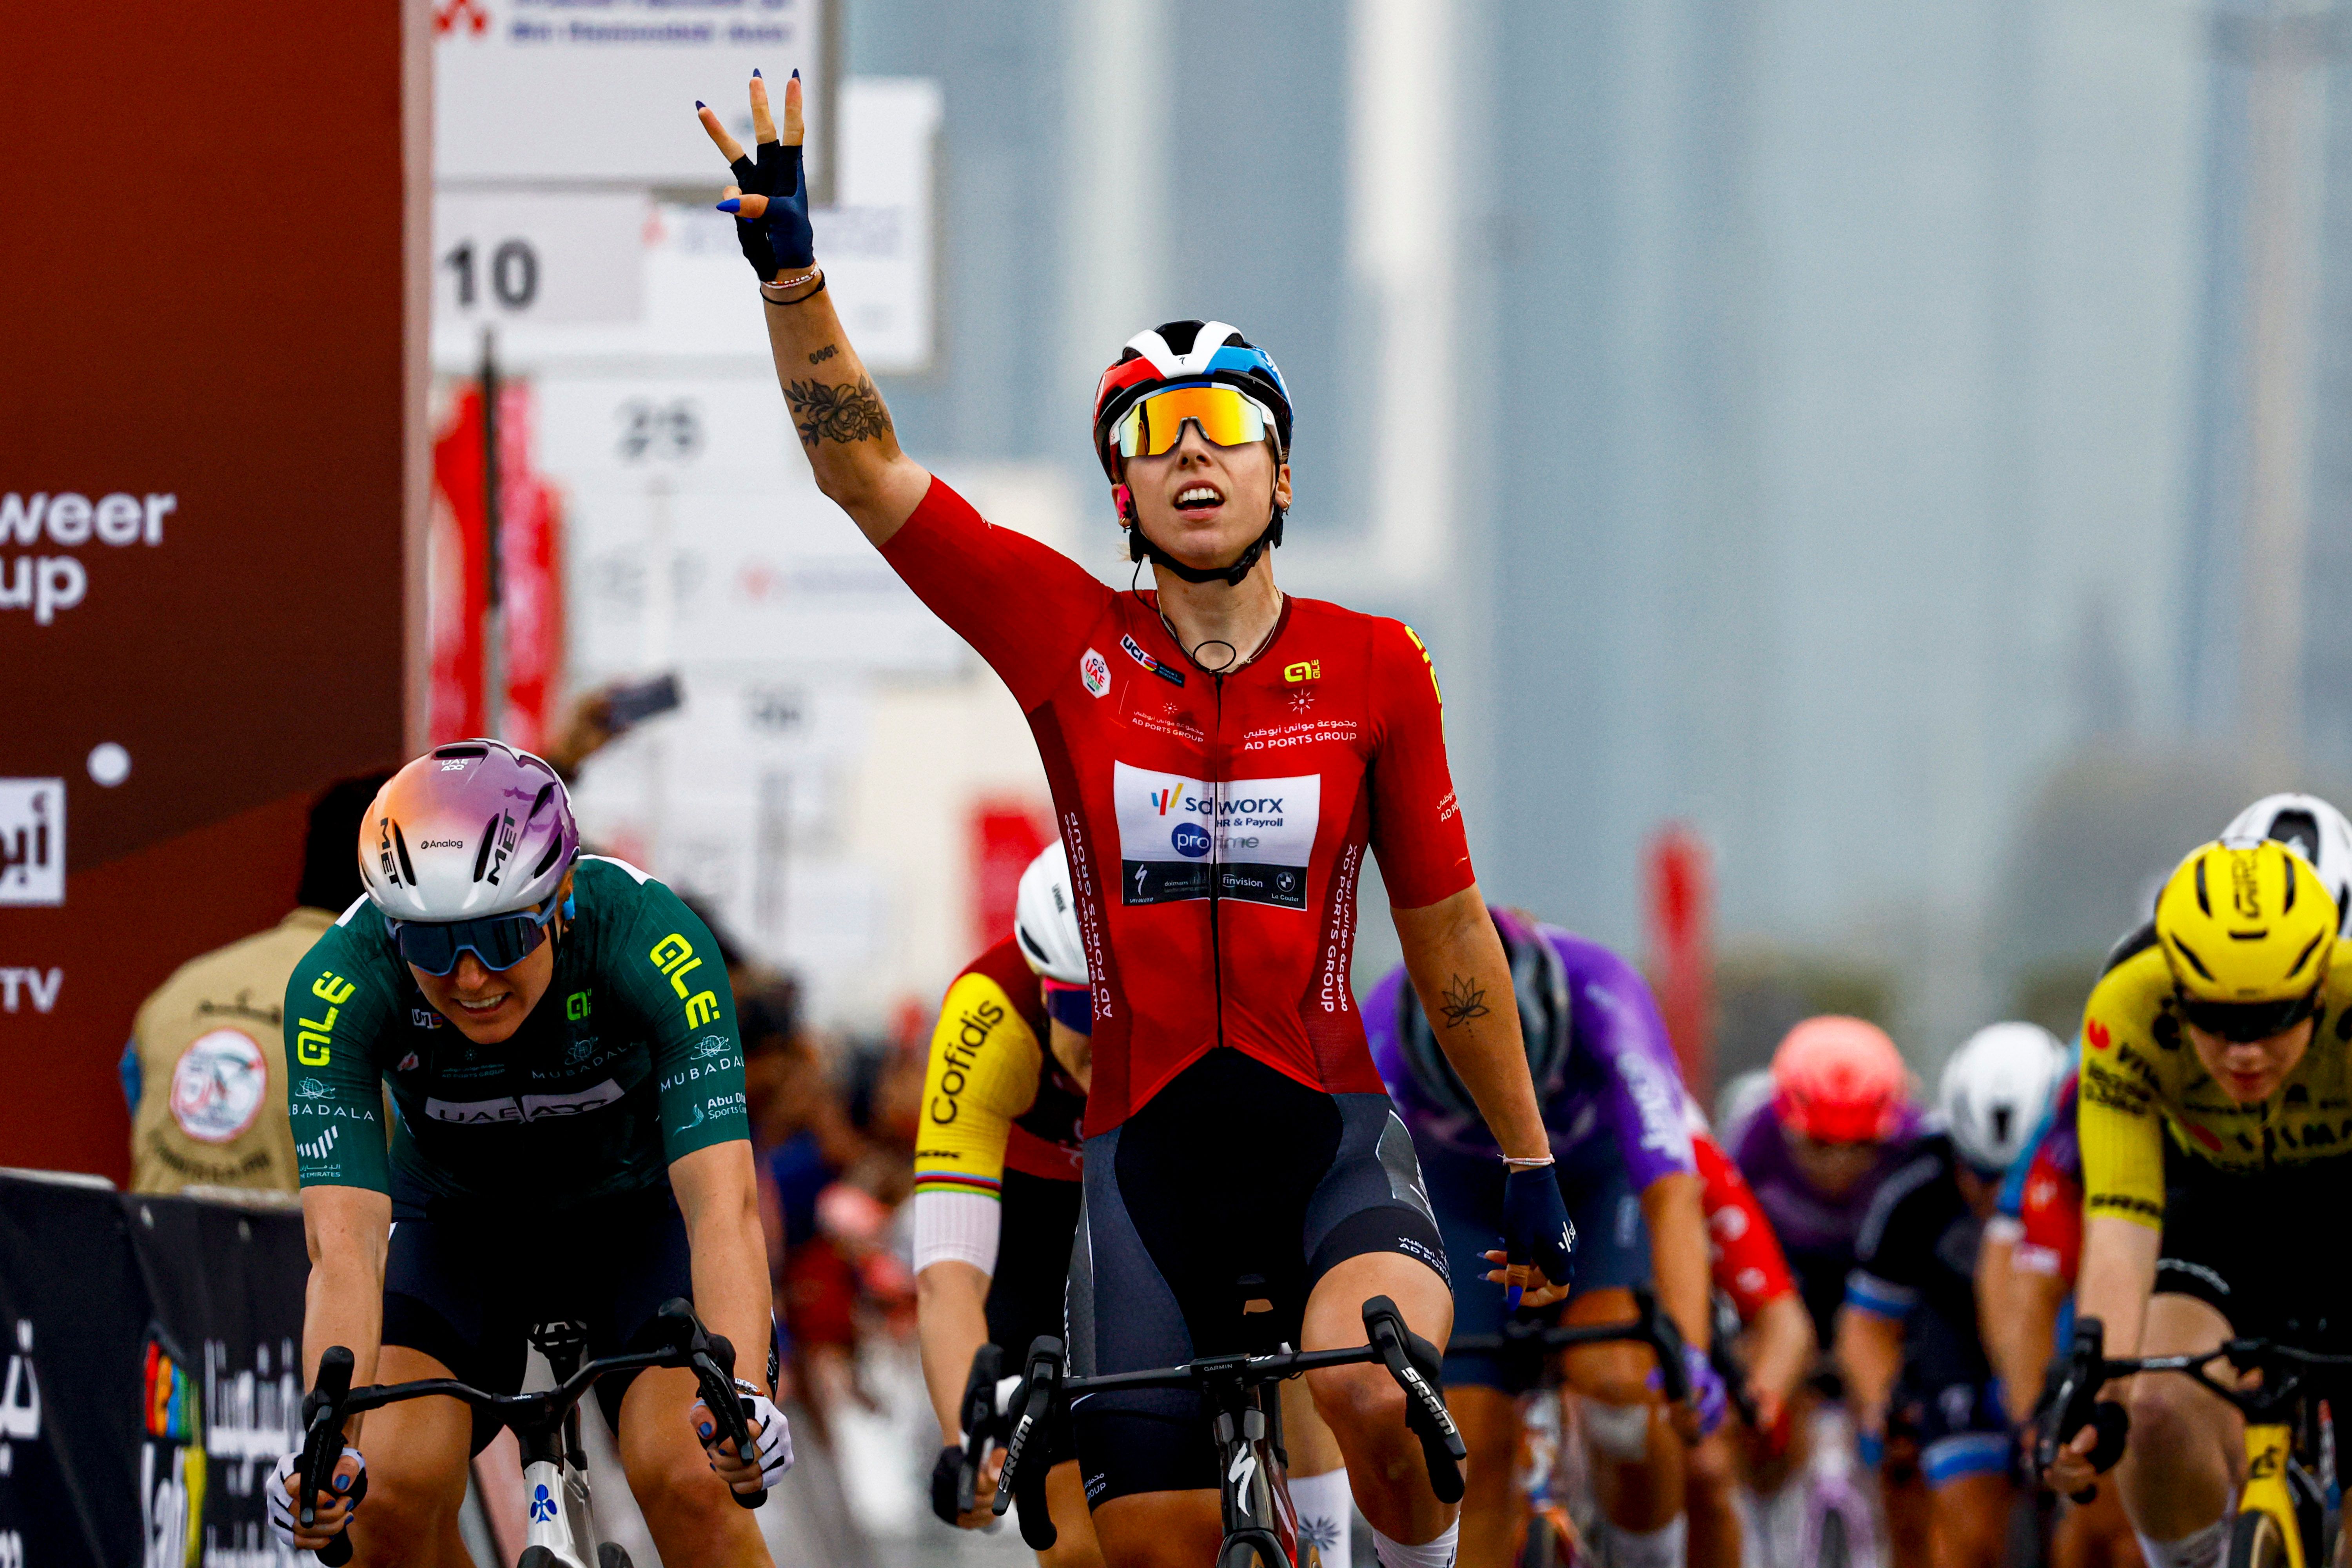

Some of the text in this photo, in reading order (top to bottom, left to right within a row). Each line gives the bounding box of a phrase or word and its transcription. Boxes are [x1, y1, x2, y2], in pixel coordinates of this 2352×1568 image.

[446, 240, 537, 310] 10
[0, 492, 176, 546] weer
[0, 555, 88, 626] up
[1123, 636, 1144, 661] UCI
[1085, 659, 1105, 688] UAE
[1132, 717, 1203, 742] AD PORTS GROUP
[1243, 725, 1281, 740] أبوظبي
[1317, 719, 1357, 728] مجموعة
[1244, 732, 1357, 750] AD PORTS GROUP
[1216, 818, 1283, 828] HR & Payroll
[1441, 809, 1452, 822] AD
[380, 817, 403, 889] MET
[430, 839, 463, 848] Analog
[487, 808, 517, 886] MET
[1223, 877, 1263, 887] finvision
[1071, 812, 1112, 1018] AD PORTS GROUP
[1321, 844, 1353, 1012] AD PORTS GROUP
[0, 967, 64, 1013] TV
[1337, 953, 1348, 1012] مجموعة
[931, 1000, 1005, 1125] Cofidis
[289, 1103, 374, 1122] BADALA
[708, 1094, 734, 1109] Abu
[708, 1106, 739, 1120] Sports
[1399, 1243, 1420, 1254] AD
[1204, 1363, 1233, 1372] GARMIN
[1401, 1367, 1455, 1435] SRAM
[998, 1414, 1033, 1493] SRAM
